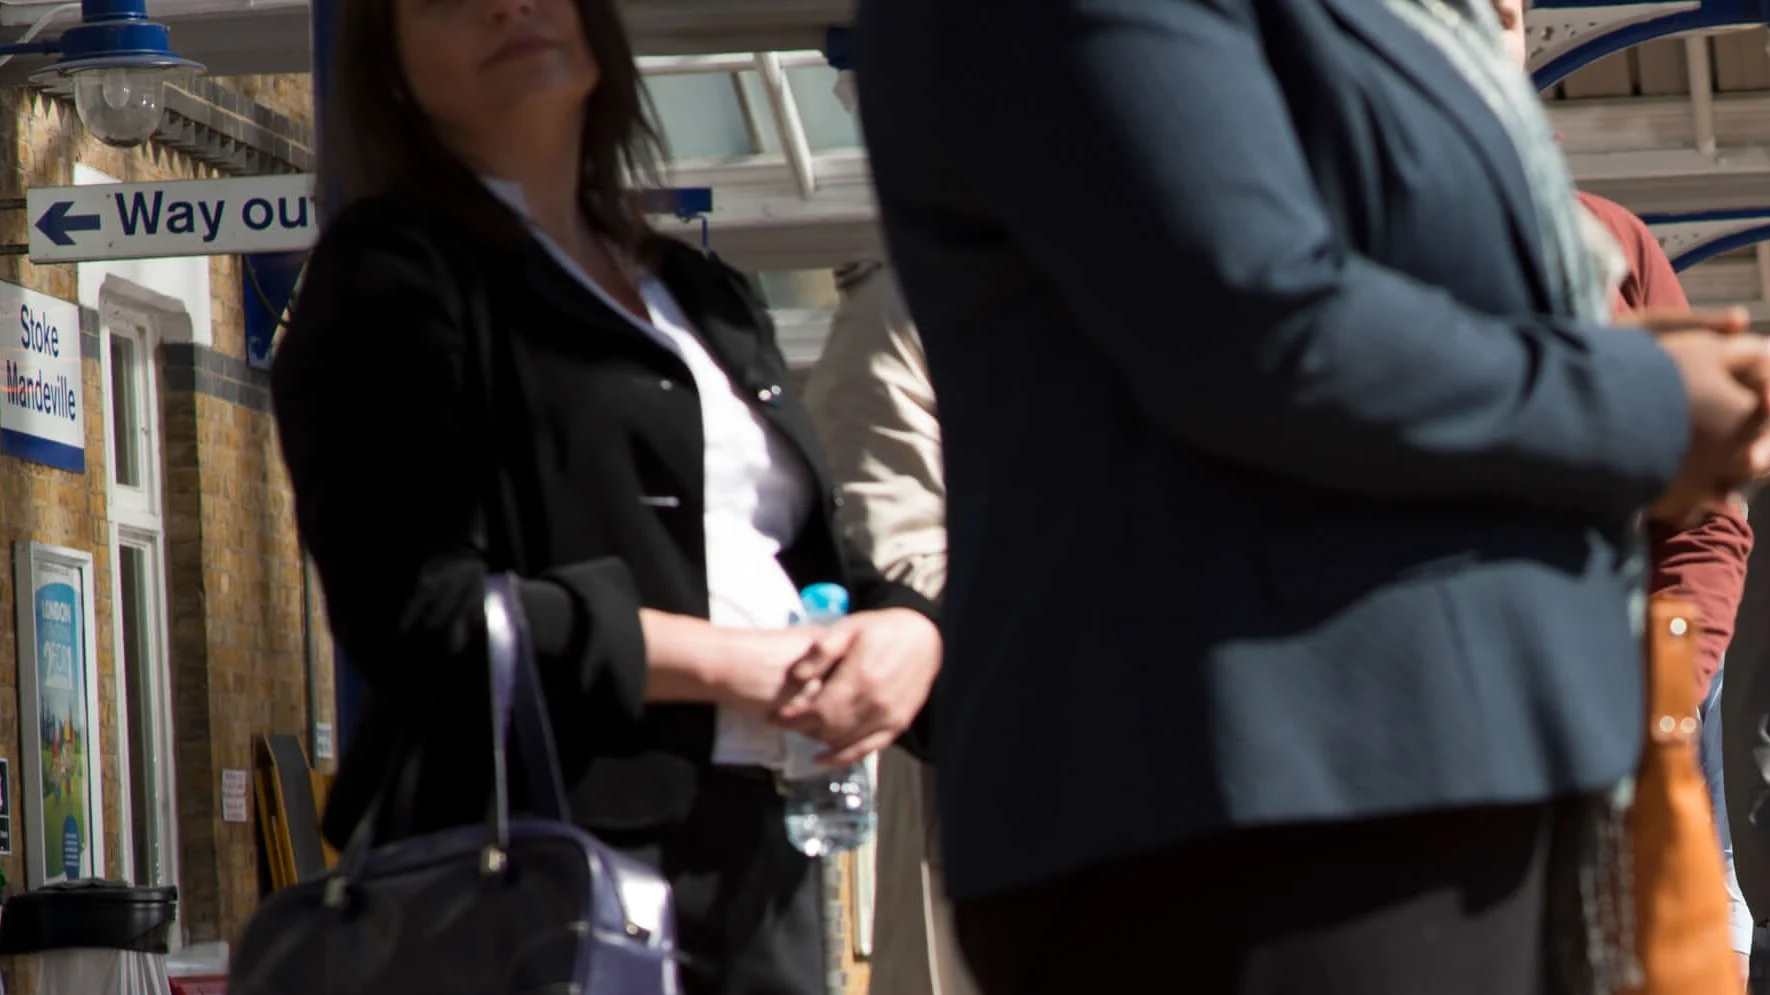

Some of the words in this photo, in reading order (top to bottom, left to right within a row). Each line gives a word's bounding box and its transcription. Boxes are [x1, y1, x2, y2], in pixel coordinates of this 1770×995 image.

[114, 190, 226, 243] Way
[241, 196, 313, 231] ou
[20, 303, 60, 359] Stoke
[6, 359, 77, 422] Mandeville
